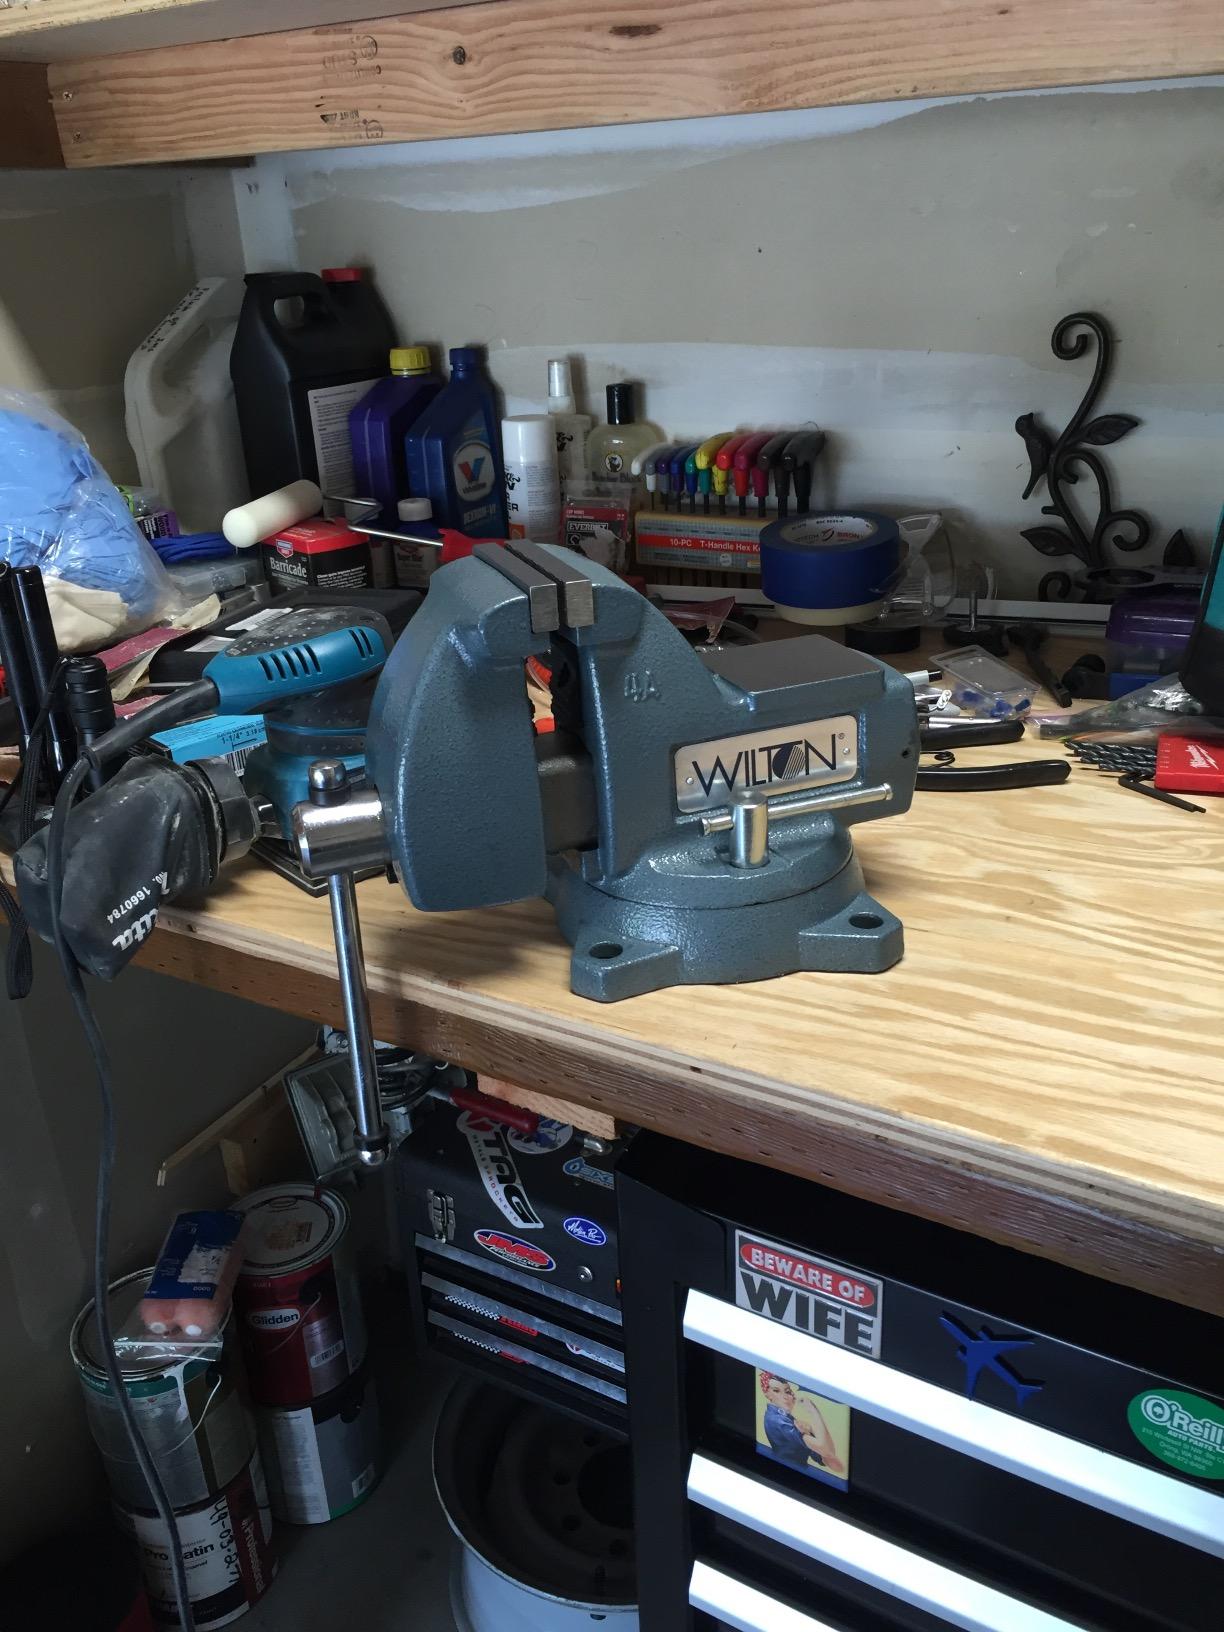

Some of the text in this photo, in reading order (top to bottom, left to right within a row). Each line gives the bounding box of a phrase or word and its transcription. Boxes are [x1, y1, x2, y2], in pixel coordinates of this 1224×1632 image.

[669, 538, 693, 547] 10-PC
[700, 540, 734, 551] T-Handle
[736, 543, 751, 551] Hex
[270, 557, 308, 578] Barricade
[692, 733, 836, 797] WILTON
[107, 886, 151, 924] 1660784
[751, 1247, 865, 1302] BEWARE OF
[252, 1312, 299, 1326] Glidden
[740, 1271, 874, 1355] WIFE
[1142, 1396, 1224, 1450] O'Reill
[1167, 1430, 1188, 1442] AUTO
[183, 1543, 215, 1560] atin
